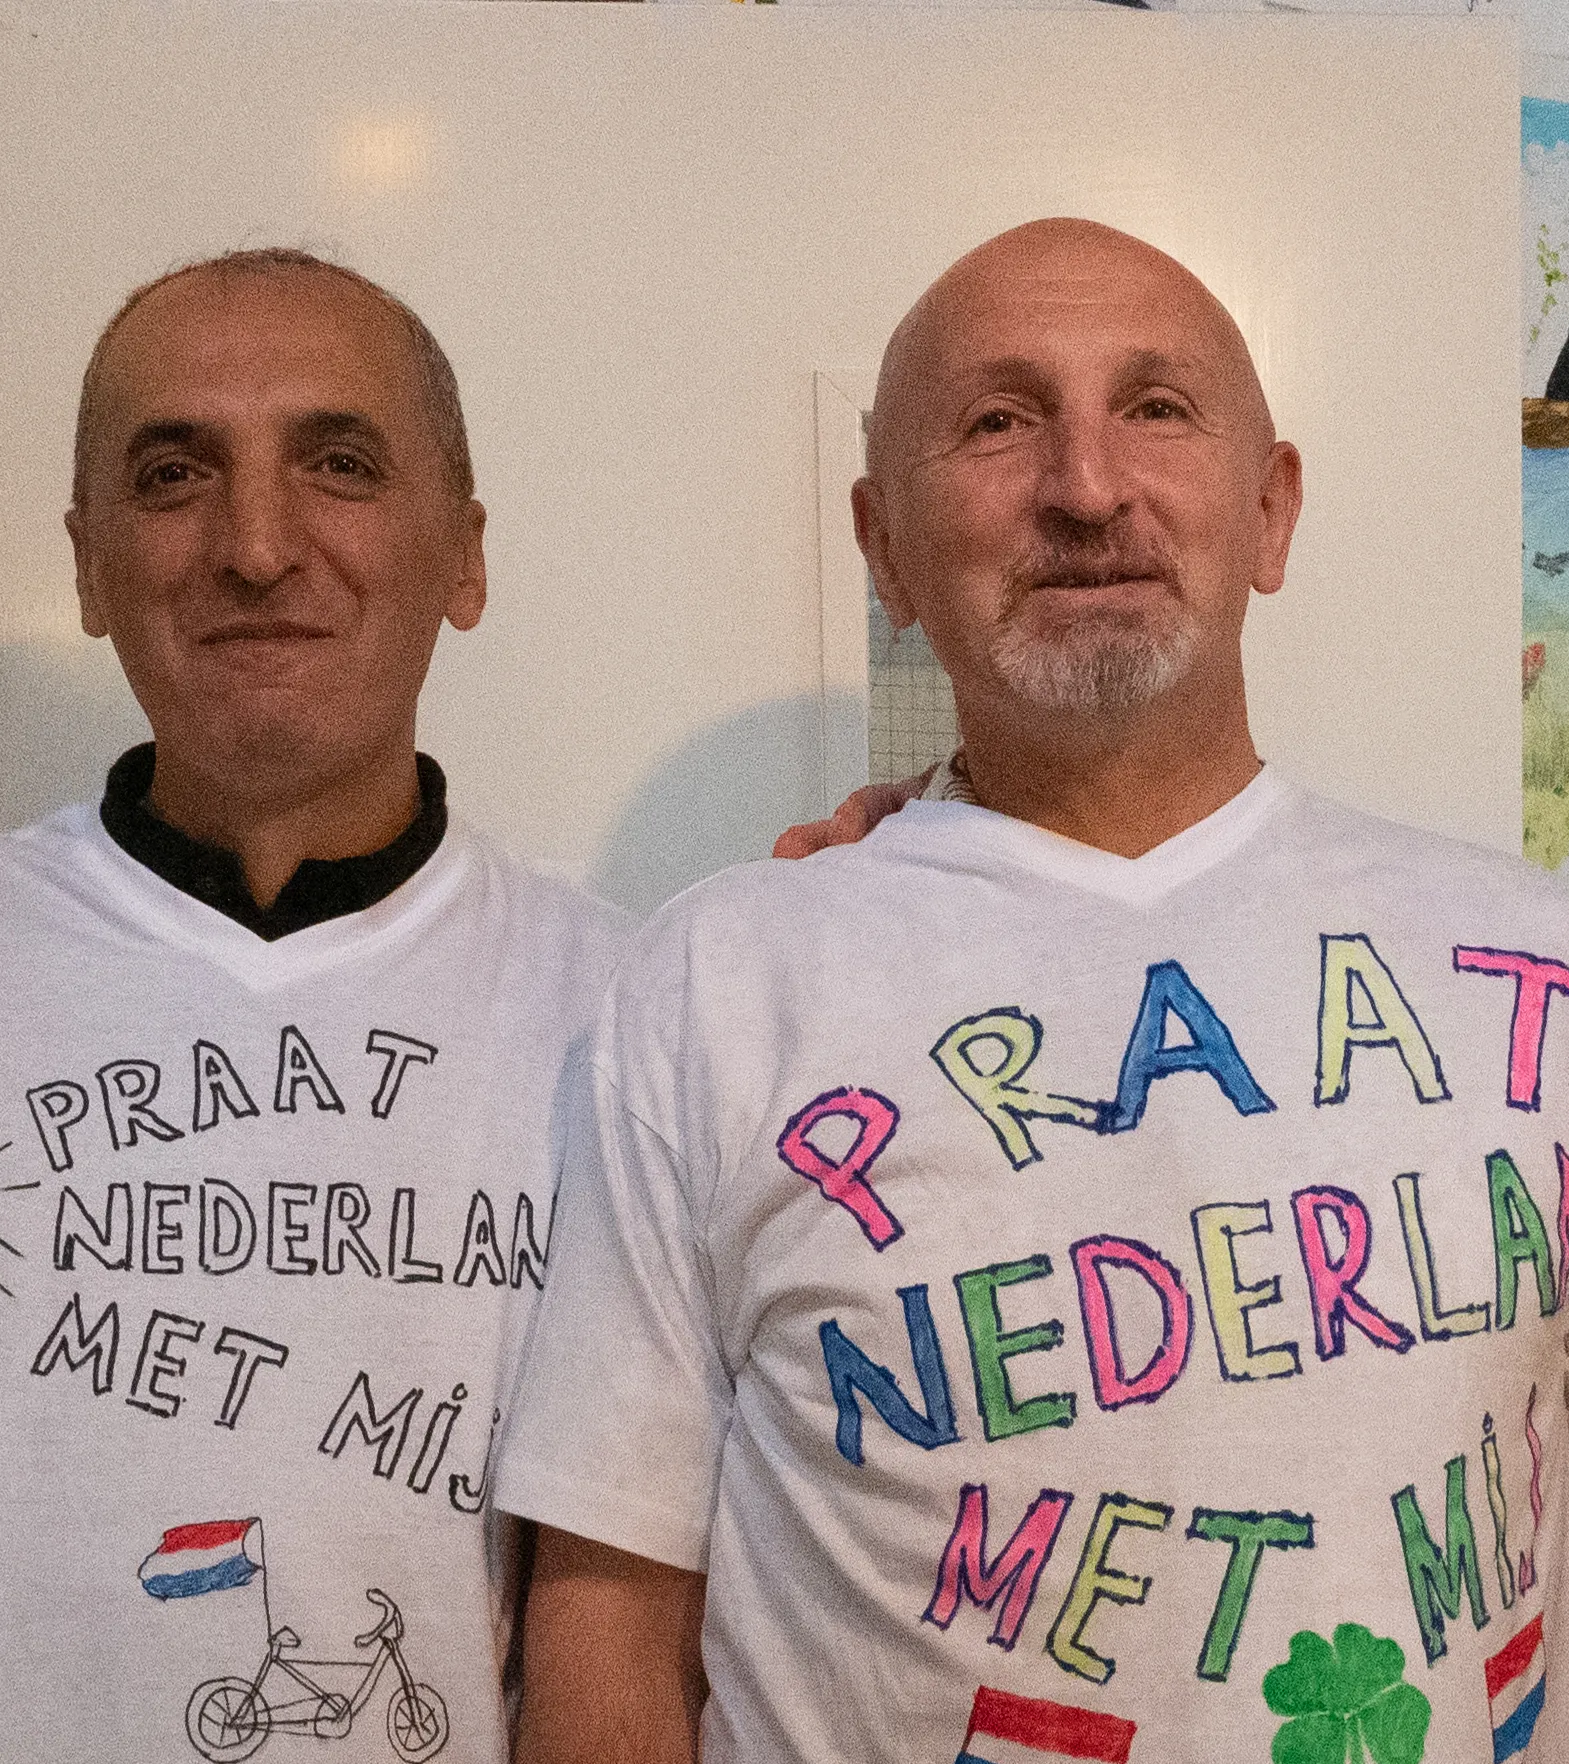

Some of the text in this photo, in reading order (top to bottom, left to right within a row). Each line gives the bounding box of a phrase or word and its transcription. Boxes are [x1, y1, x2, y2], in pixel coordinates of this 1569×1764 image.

[26, 1025, 439, 1171] PRAAT
[31, 1292, 290, 1431] MET
[921, 1483, 1316, 1685] MET
